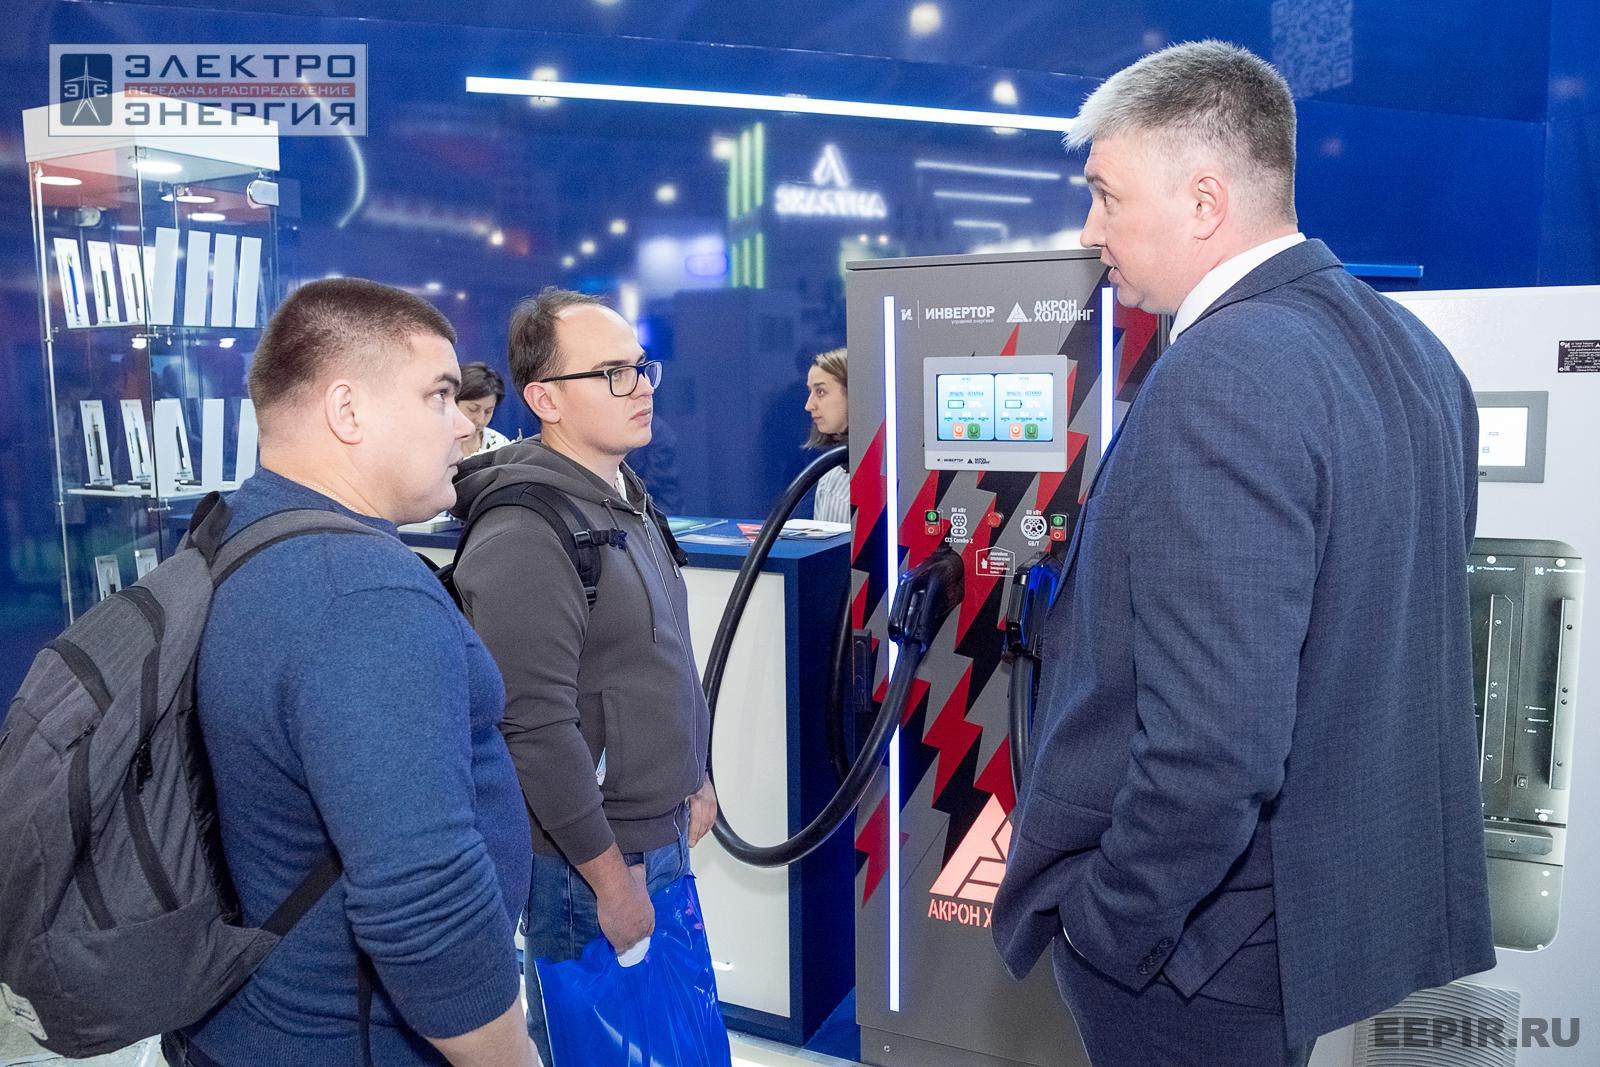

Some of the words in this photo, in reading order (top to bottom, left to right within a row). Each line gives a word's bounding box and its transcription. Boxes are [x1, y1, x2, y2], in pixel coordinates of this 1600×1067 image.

[1034, 299, 1077, 312] АКРОН
[925, 306, 996, 320] ИНВЕРТОР
[1034, 309, 1094, 324] ХОЛДИНГ
[927, 898, 980, 927] АКРОН
